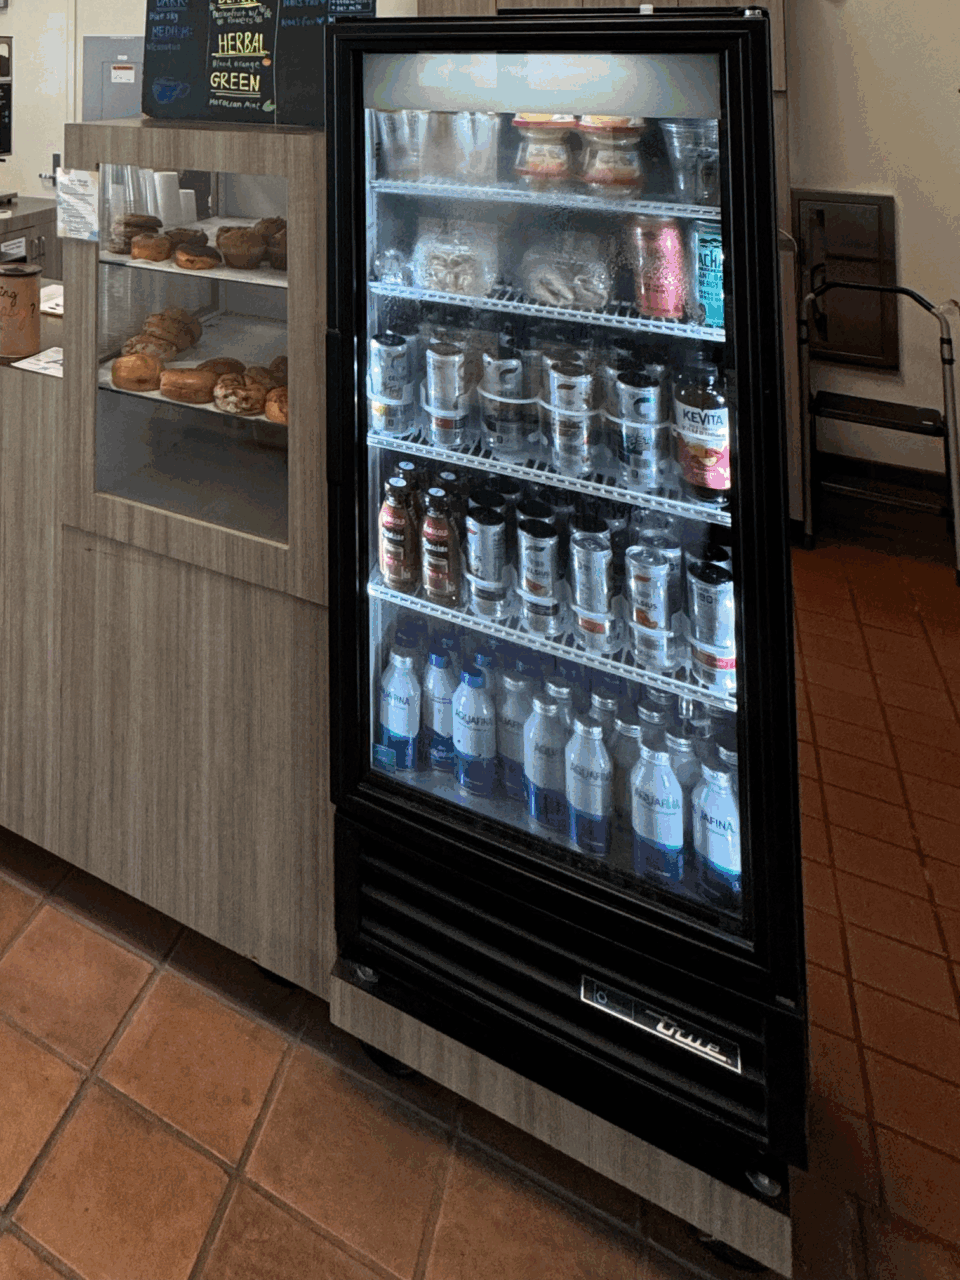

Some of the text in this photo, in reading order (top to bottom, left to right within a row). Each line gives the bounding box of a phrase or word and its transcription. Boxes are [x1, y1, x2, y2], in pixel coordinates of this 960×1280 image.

[218, 31, 265, 55] HERBAL
[210, 71, 261, 92] GREEN
[683, 409, 724, 426] KEVITA
